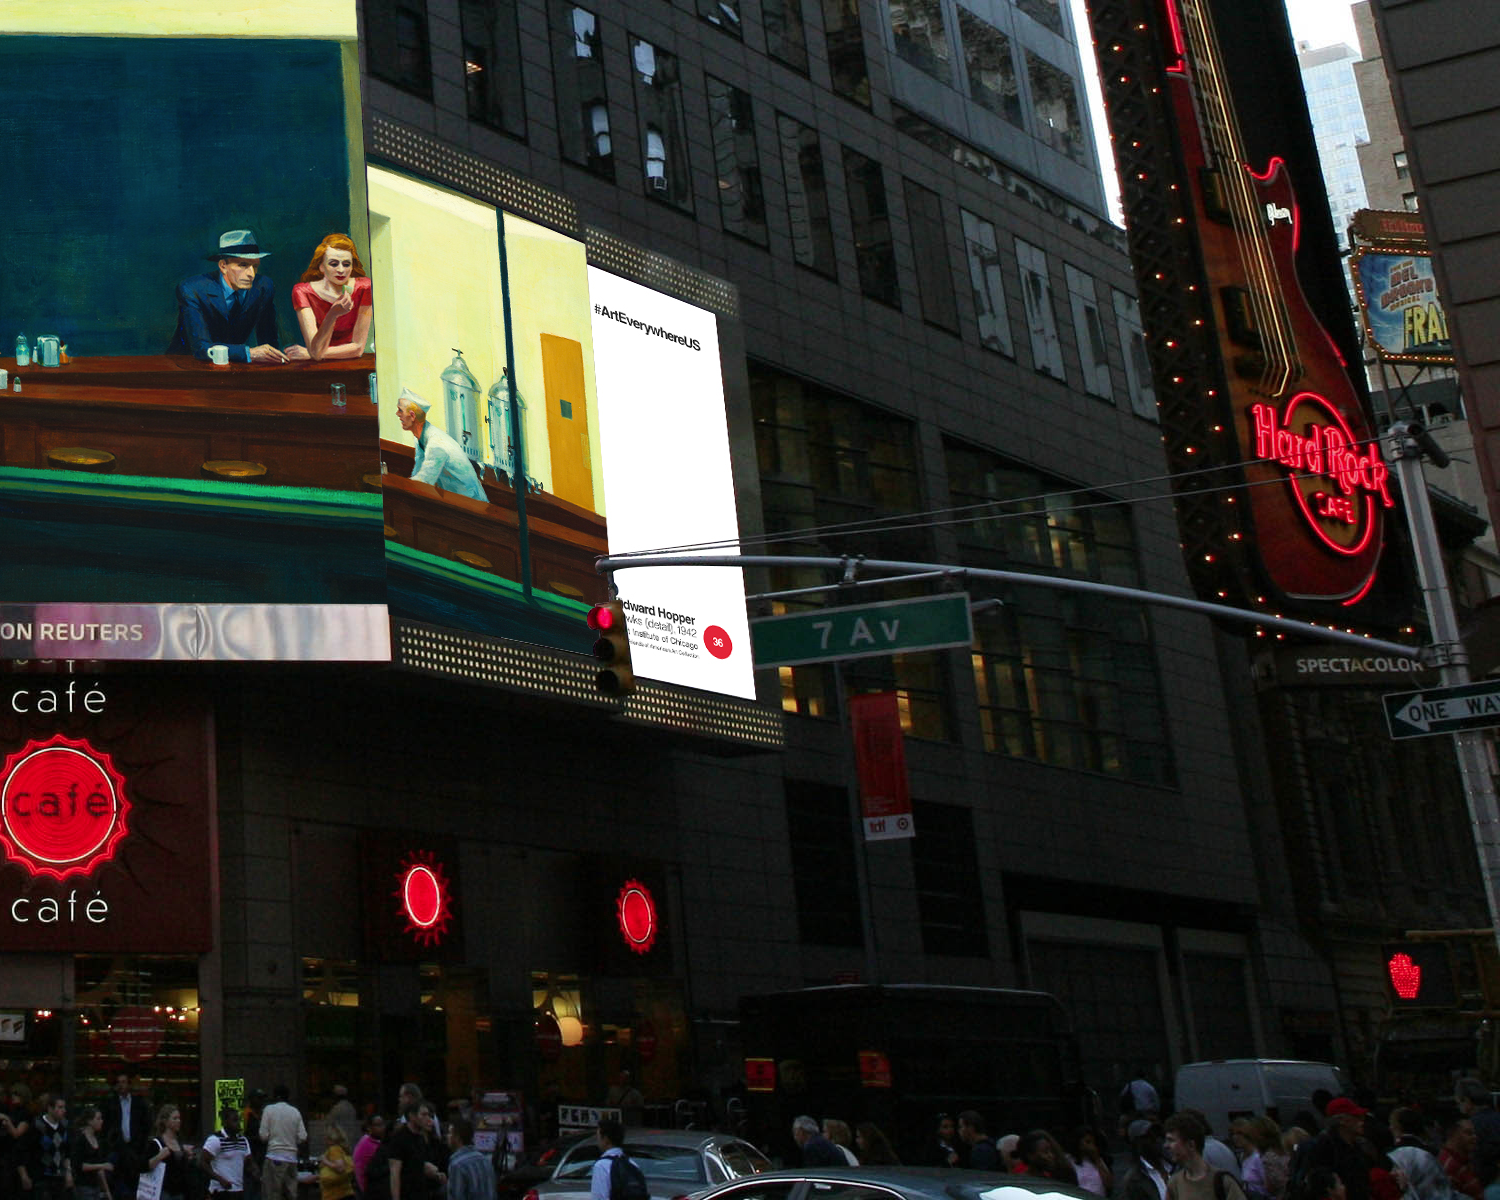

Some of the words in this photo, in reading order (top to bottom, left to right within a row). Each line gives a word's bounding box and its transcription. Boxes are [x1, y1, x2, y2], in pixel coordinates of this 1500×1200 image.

[594, 304, 701, 351] #ArtEverywhereUS
[1252, 402, 1323, 474] Hard
[1323, 425, 1395, 508] Rock
[622, 600, 655, 616] dward
[658, 607, 695, 625] Hopper
[41, 623, 143, 642] REUTERS
[670, 637, 699, 651] Chicago
[677, 625, 698, 638] 1942
[713, 637, 724, 648] 36
[812, 621, 833, 650] 7
[12, 682, 107, 714] café
[1408, 702, 1449, 722] ONE
[12, 783, 109, 818] café
[11, 890, 109, 923] café
